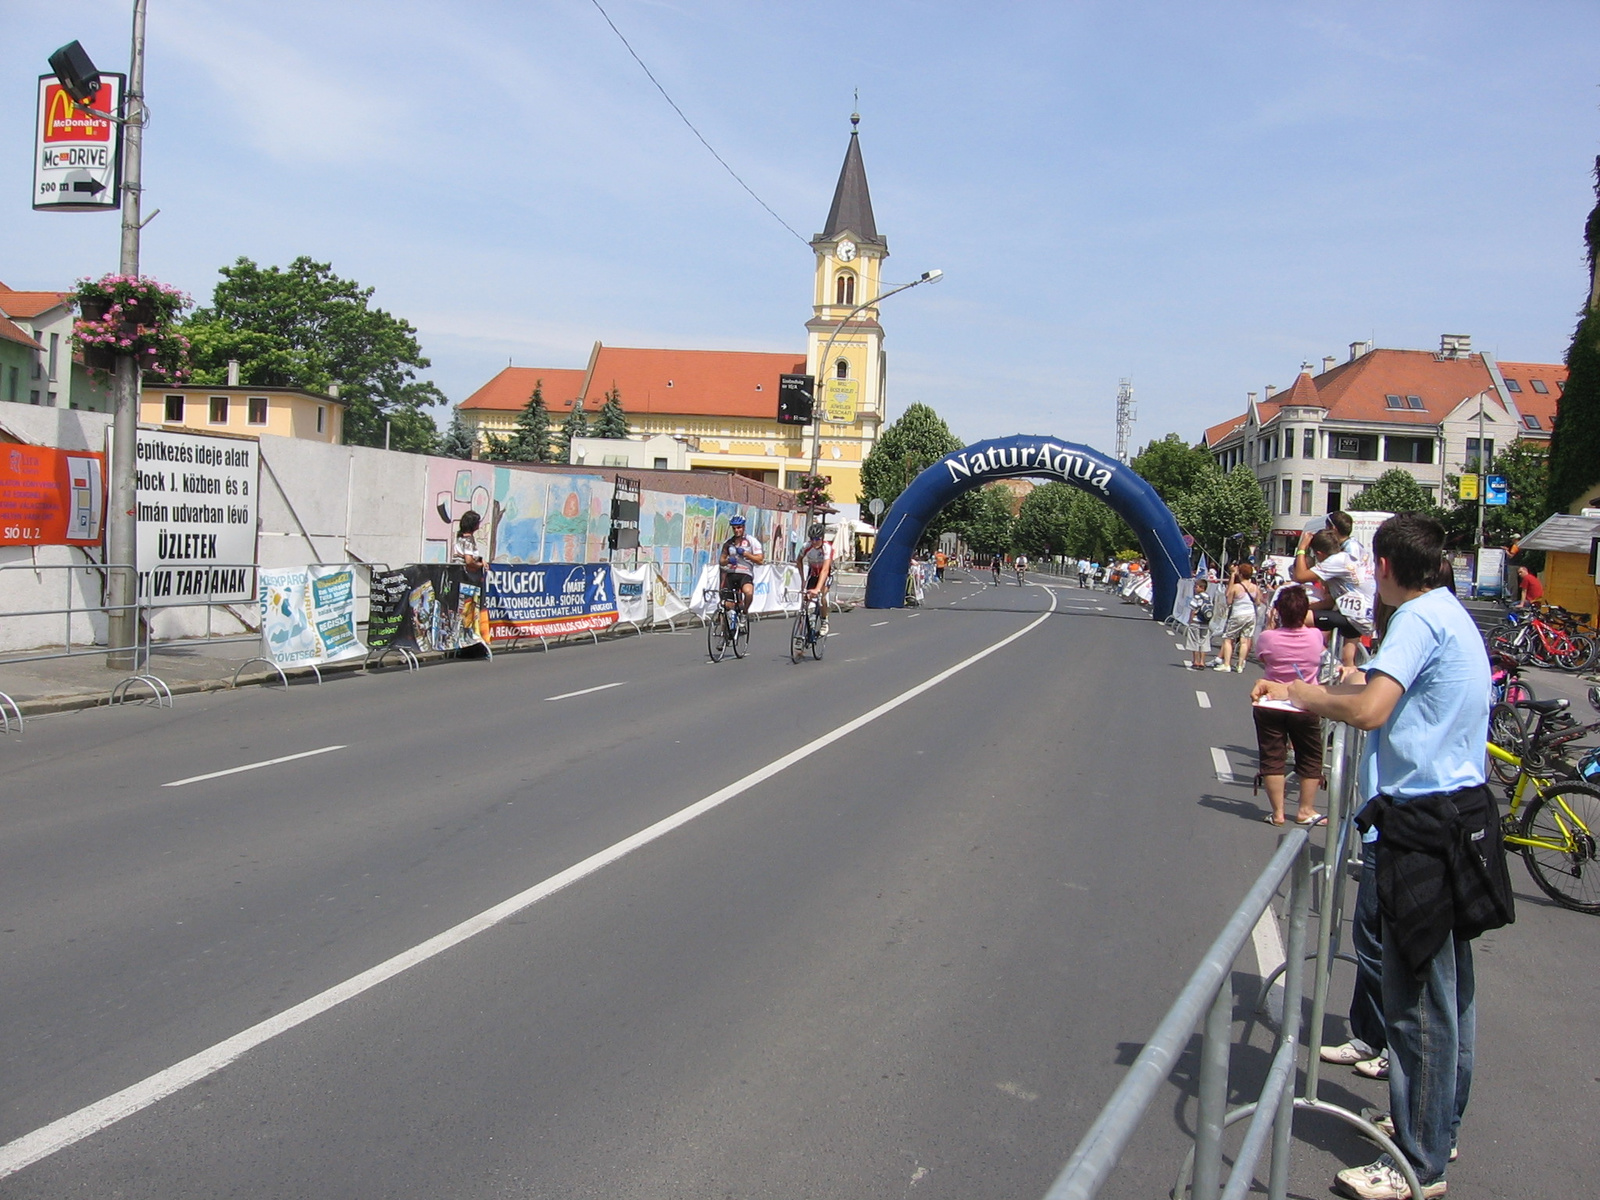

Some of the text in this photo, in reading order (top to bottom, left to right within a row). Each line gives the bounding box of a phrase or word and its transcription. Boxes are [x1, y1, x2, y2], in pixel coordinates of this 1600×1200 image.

[53, 119, 107, 127] McDonald's
[69, 148, 106, 166] DRIVE
[41, 182, 69, 194] 500 m
[137, 439, 249, 467] építkezés ideje alatt
[944, 443, 1113, 491] NaturAqua
[136, 470, 249, 496] Hock J. közben és a
[173, 504, 224, 524] udvarban
[228, 505, 249, 524] lévő
[4, 523, 41, 539] SIÓ U. 2
[158, 529, 217, 560] ÜZLETEK
[176, 569, 246, 596] TARTANAK
[485, 571, 585, 594] PEUGEOT MÁTÉ
[560, 592, 586, 605] SIÓFOK
[1339, 597, 1362, 611] 1113
[489, 627, 494, 637] A
